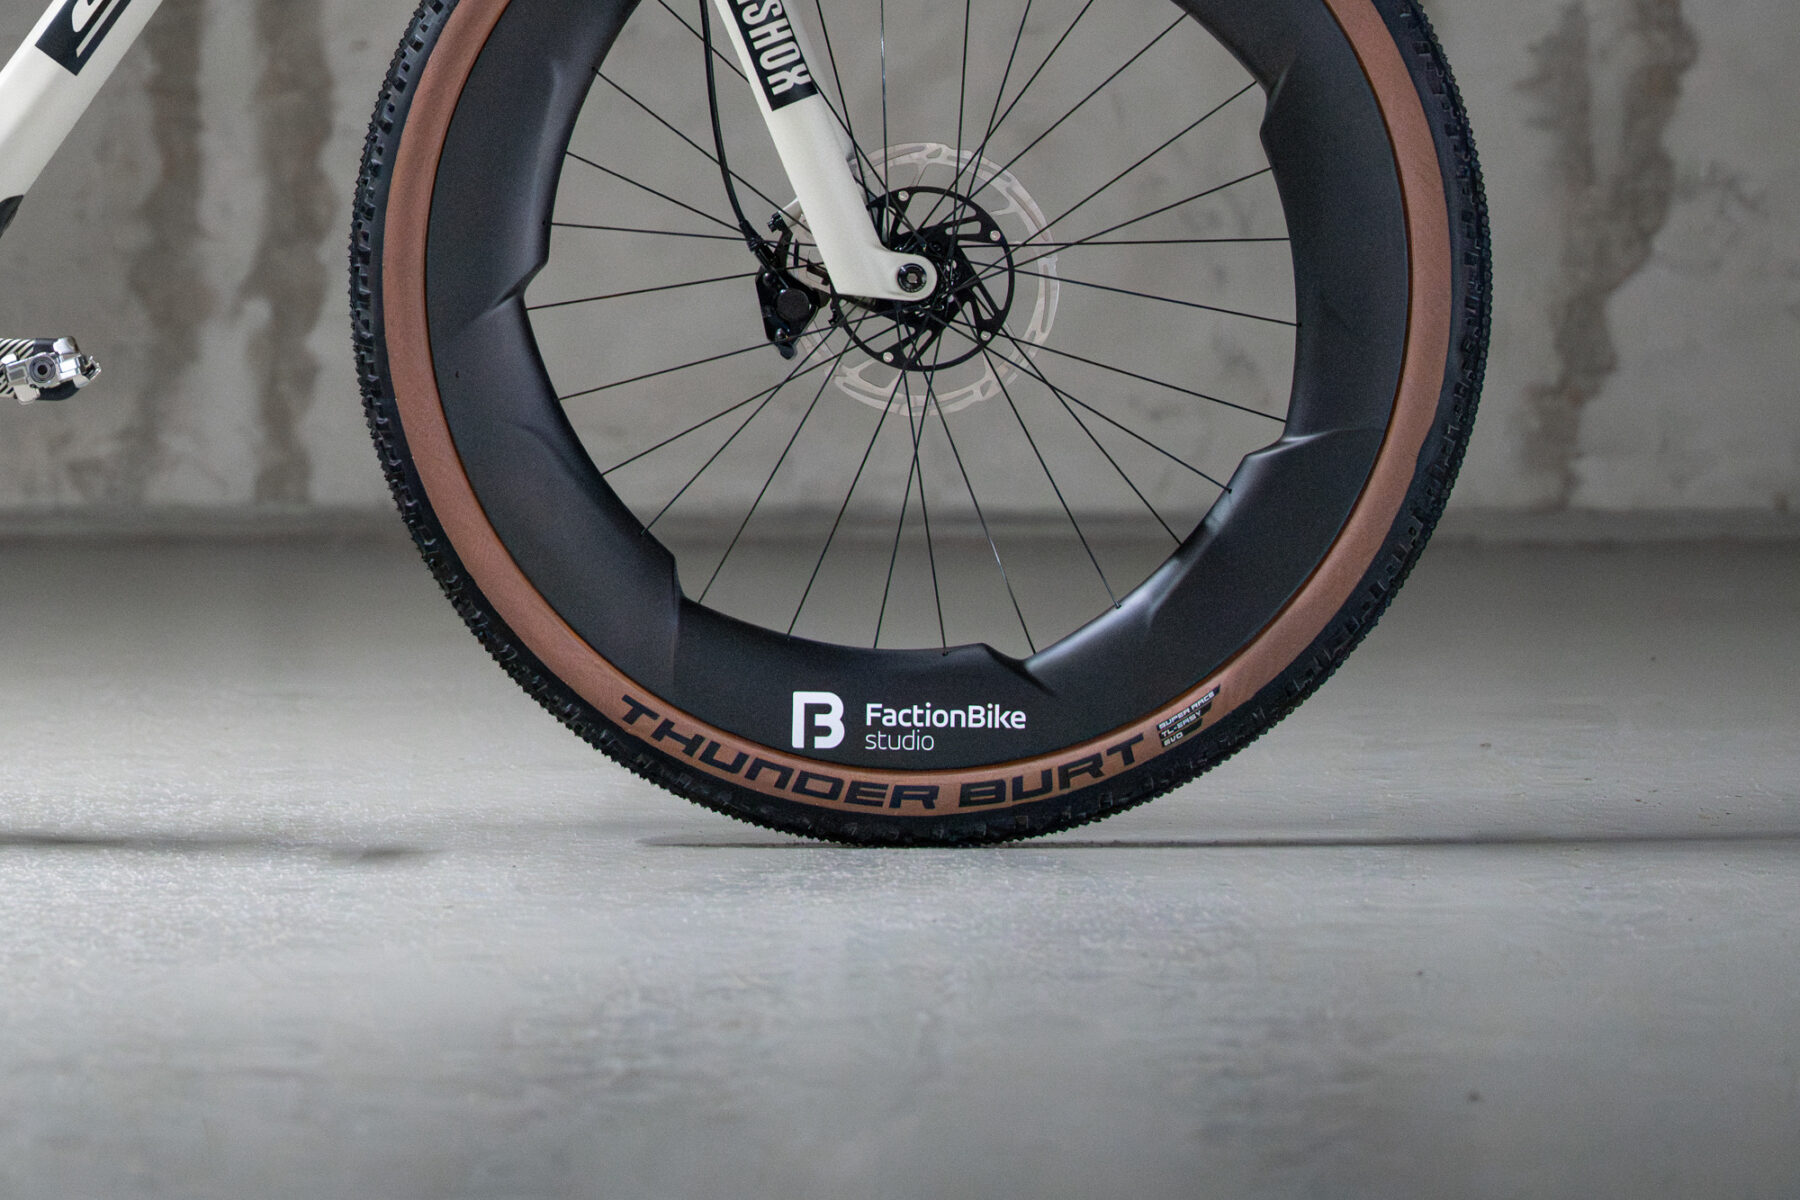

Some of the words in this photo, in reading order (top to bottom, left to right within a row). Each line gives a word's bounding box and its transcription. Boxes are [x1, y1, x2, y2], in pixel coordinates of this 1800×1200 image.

[866, 702, 1027, 730] FactionBike
[1158, 707, 1190, 730] SUPER
[1190, 691, 1215, 711] RACE
[1161, 709, 1201, 738] TL-EASY
[620, 693, 941, 810] THUNDER
[957, 732, 1145, 810] BURT
[865, 729, 935, 751] studio
